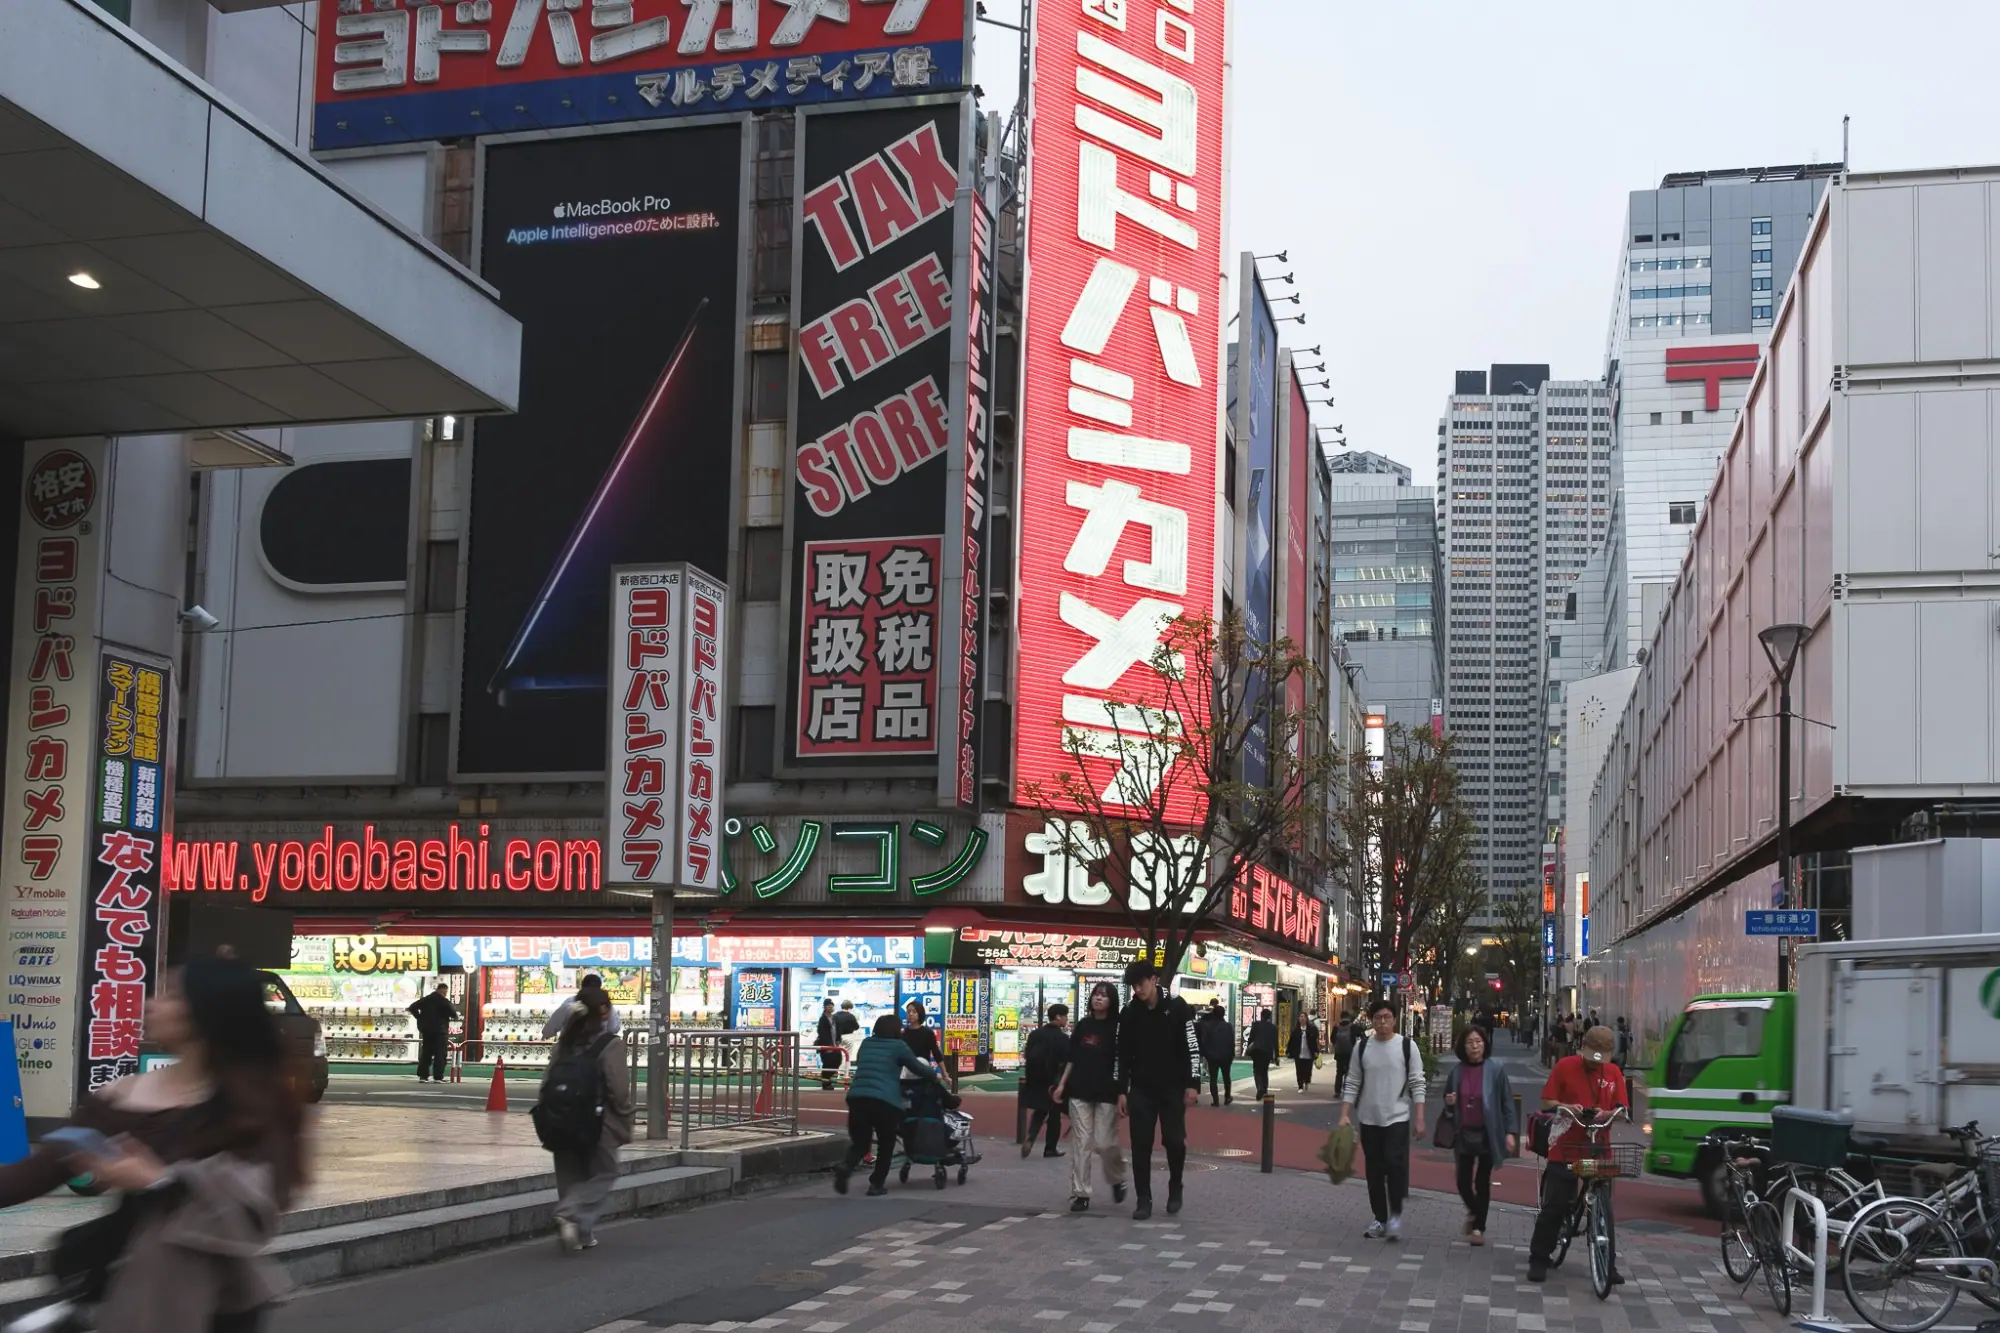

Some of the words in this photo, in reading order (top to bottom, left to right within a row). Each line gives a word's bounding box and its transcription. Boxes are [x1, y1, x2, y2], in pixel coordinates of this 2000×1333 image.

[635, 47, 932, 107] マルチメディア館
[566, 198, 641, 218] MacBook
[643, 196, 671, 211] Pro
[804, 120, 959, 273] TAX
[507, 226, 549, 245] Apple
[799, 252, 952, 400] FREE
[966, 200, 991, 531] ヨドバシカメラ
[1060, 30, 1202, 806] ヨドバシカメラ
[796, 374, 949, 518] STORE
[32, 461, 86, 502] 格安
[43, 497, 86, 522] スマホ
[619, 574, 681, 587] 新宿西口本店
[806, 551, 868, 742] 取扱店
[874, 546, 935, 740] 免税品
[24, 536, 78, 881] ヨドバシカメラ
[103, 660, 134, 756] スマートフォン
[621, 587, 671, 881] ヨドバシカメラ
[687, 591, 718, 884] ヨドバシカメラ
[11, 908, 42, 920] Rakuten
[42, 908, 67, 918] Mobile
[35, 931, 67, 940] MOBILE
[18, 955, 53, 966] GATE
[19, 946, 55, 954] WIRELESS
[89, 831, 154, 1060] なんでも相談
[26, 975, 62, 985] WiMAX
[27, 995, 61, 1005] mobile
[739, 982, 774, 1002] 酒店
[15, 1038, 57, 1051] GLOBE
